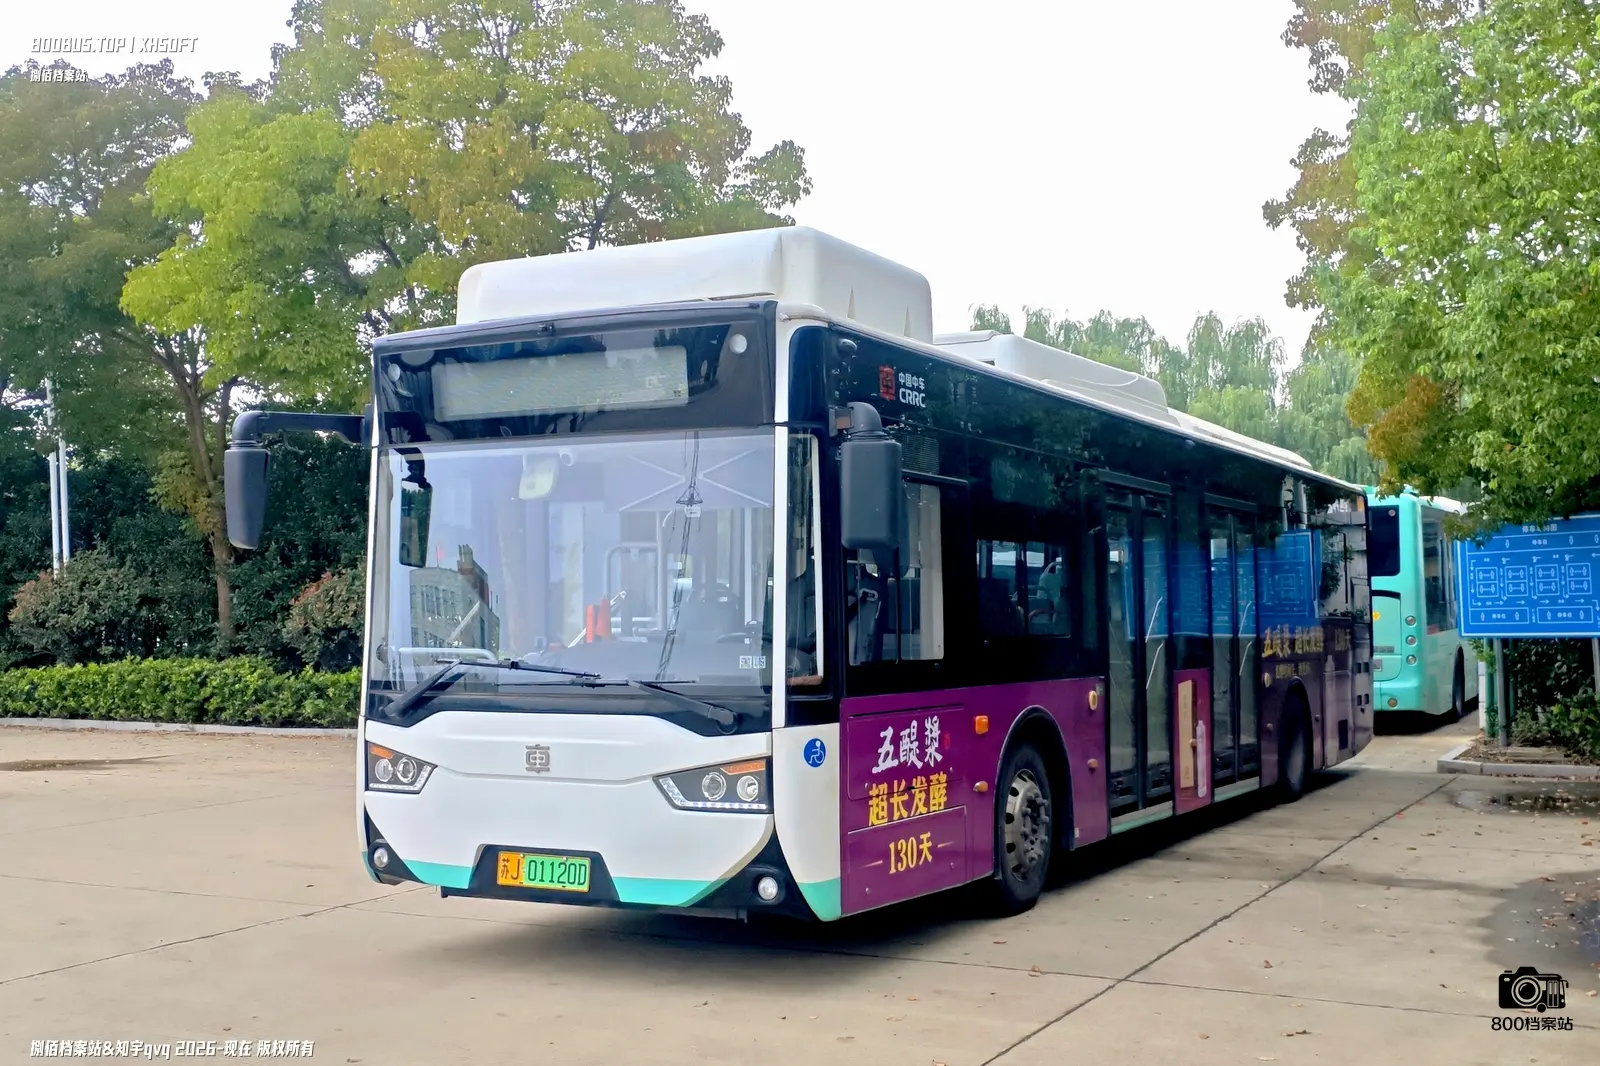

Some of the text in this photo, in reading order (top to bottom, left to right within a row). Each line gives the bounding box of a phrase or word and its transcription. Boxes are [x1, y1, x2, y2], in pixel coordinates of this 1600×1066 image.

[898, 371, 926, 390] 中国中车
[899, 387, 926, 408] CRRC
[868, 770, 948, 826] 超长发酵
[889, 831, 933, 874] 130天
[527, 859, 587, 886] 01120D
